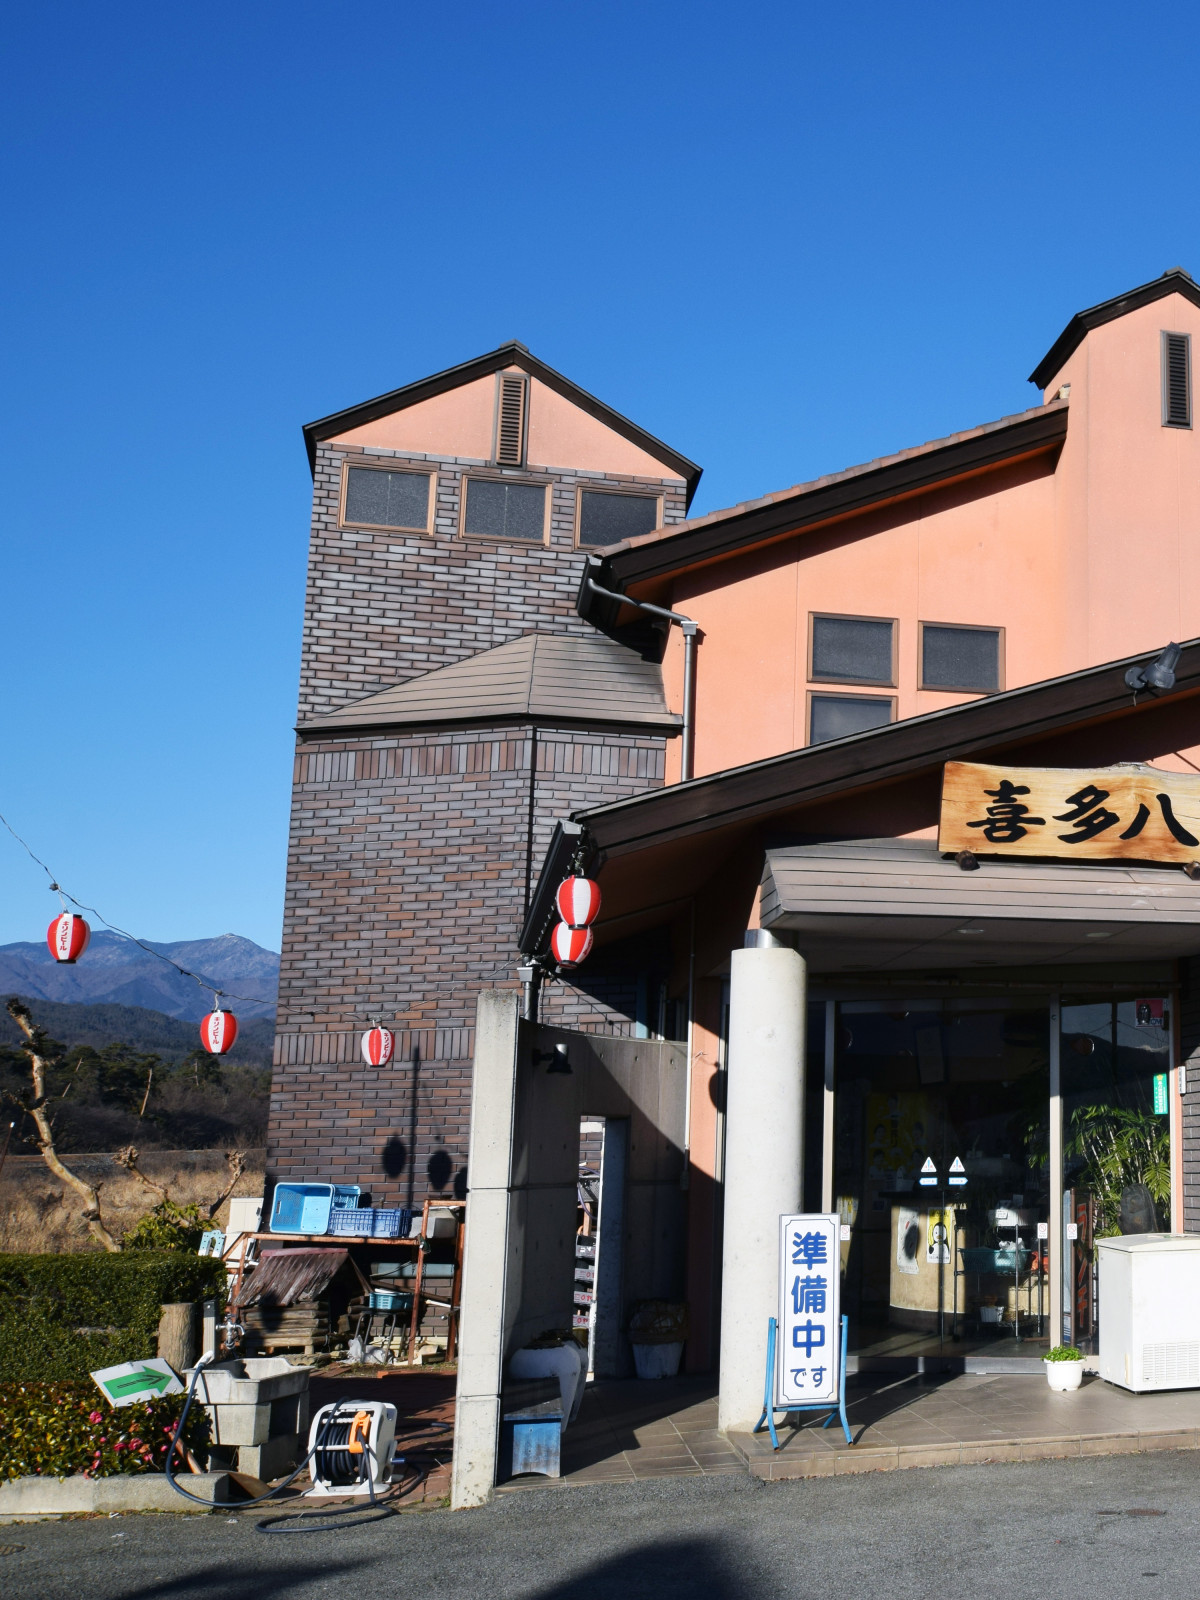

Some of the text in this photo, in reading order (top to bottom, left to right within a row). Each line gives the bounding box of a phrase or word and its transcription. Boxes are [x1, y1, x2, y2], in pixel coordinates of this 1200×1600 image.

[966, 779, 1200, 847] 喜多八
[60, 921, 69, 951] キリンビール
[791, 1231, 828, 1359] 準備中
[1077, 1203, 1087, 1328] ランチ
[790, 1365, 827, 1388] です
